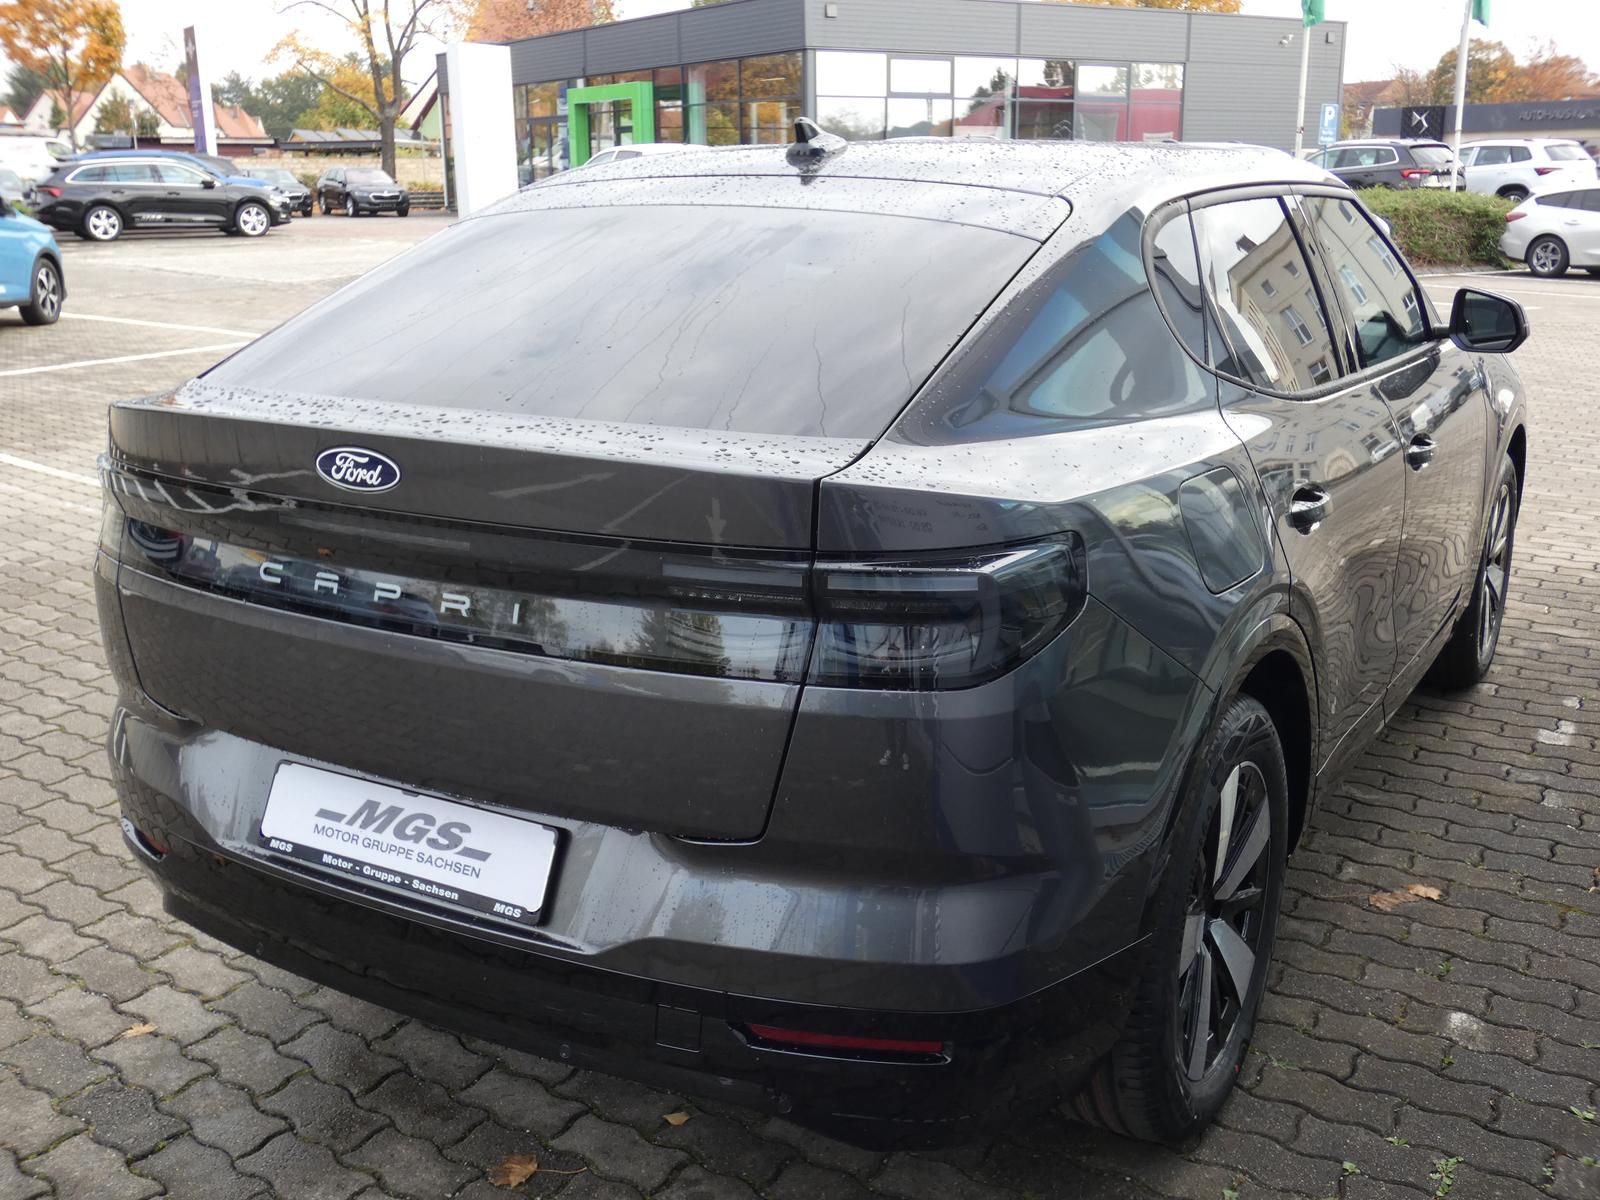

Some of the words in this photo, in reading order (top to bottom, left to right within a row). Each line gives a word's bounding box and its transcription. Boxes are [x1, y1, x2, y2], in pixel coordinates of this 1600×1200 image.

[1324, 106, 1336, 127] P
[330, 452, 383, 486] Ford
[259, 561, 521, 625] CAPRI
[269, 838, 294, 854] MGS
[346, 799, 472, 852] MGS
[313, 823, 360, 846] MOTOR
[362, 837, 413, 861] GRUPPE
[416, 851, 481, 880] SACHSEN
[322, 853, 354, 871] Motor
[362, 864, 402, 885] Gruppe
[412, 878, 459, 901] Sachsen
[492, 902, 522, 919] MGS
